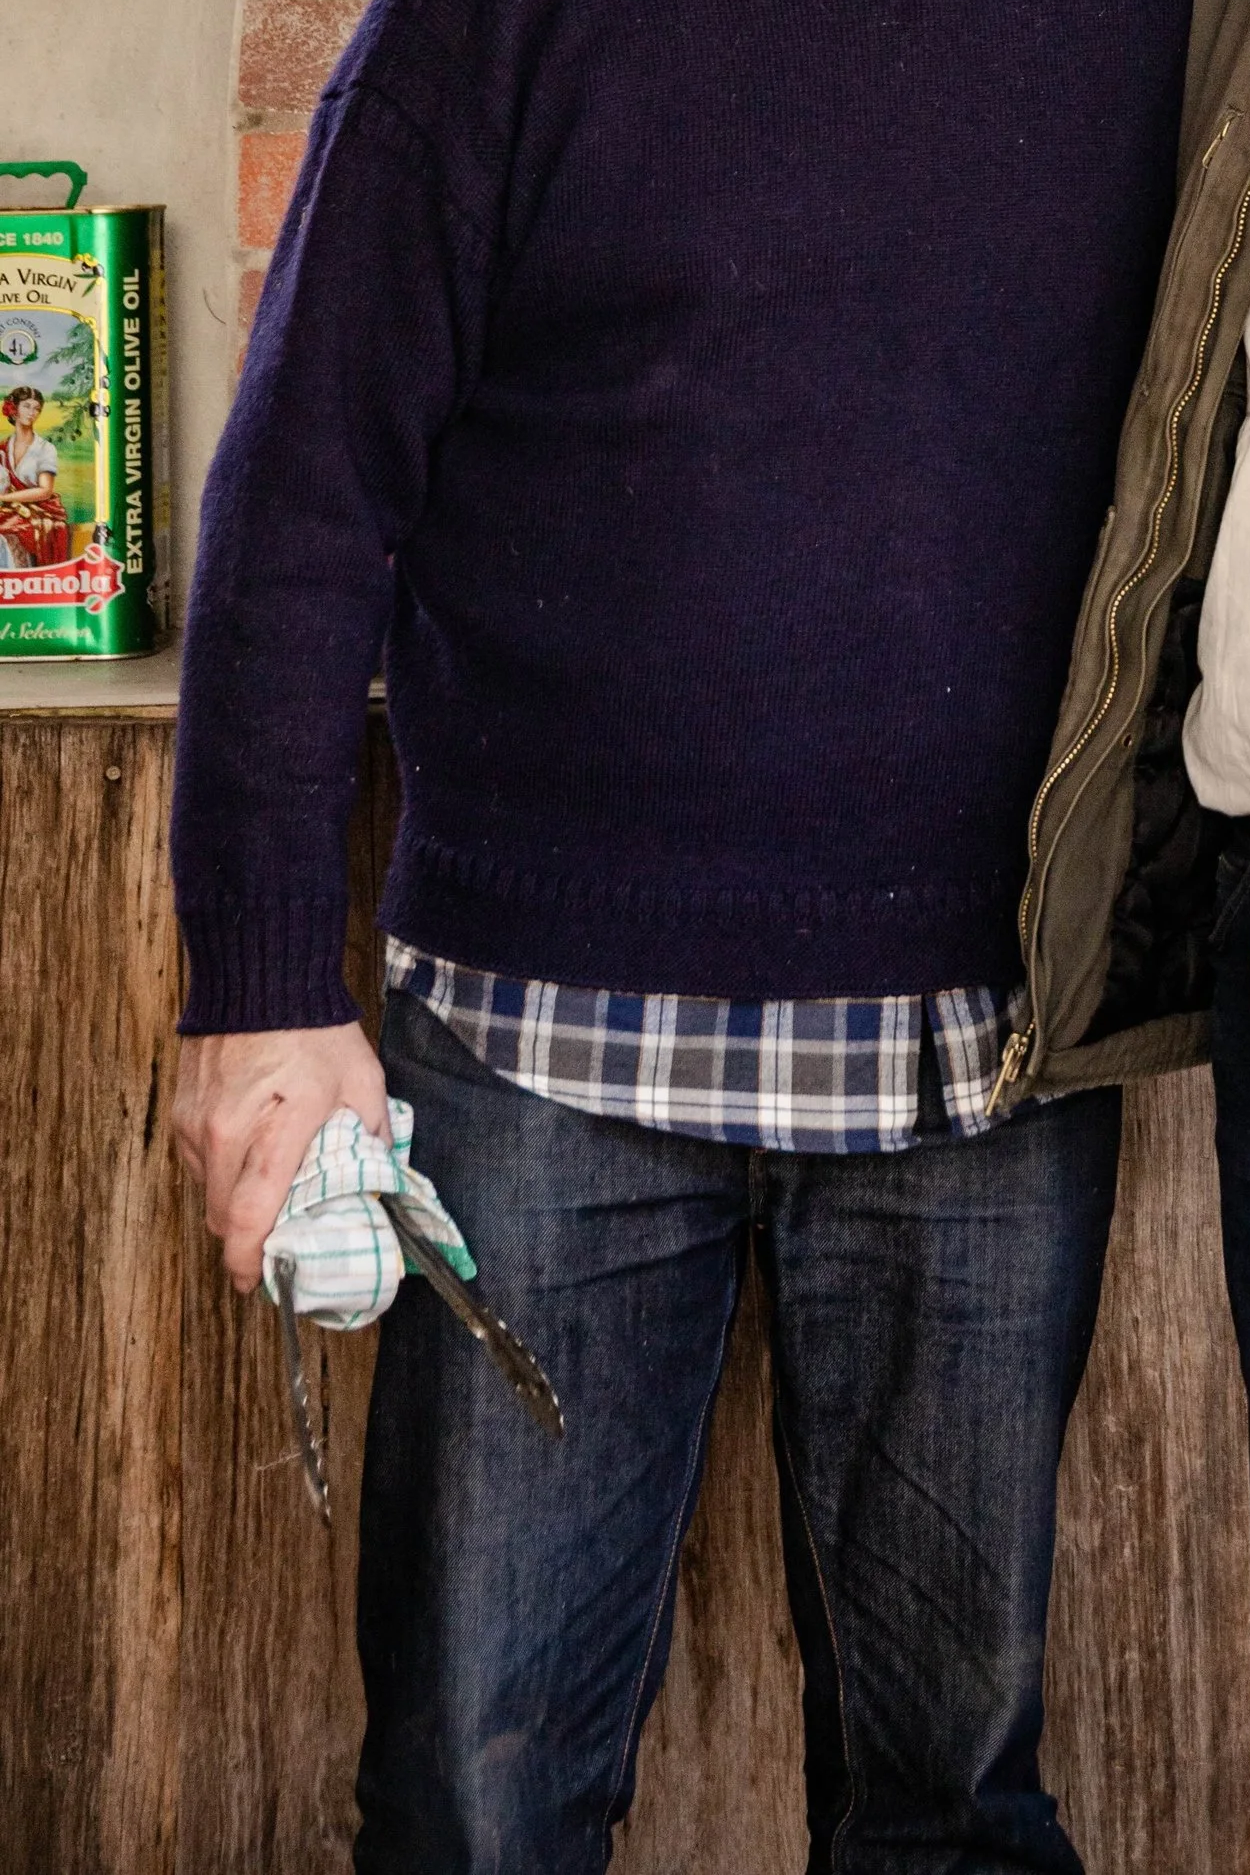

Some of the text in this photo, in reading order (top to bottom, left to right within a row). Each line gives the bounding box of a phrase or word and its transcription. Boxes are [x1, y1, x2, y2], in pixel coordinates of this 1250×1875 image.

[23, 232, 64, 246] 1840
[17, 268, 78, 293] VIRGIN
[26, 289, 52, 305] OIL
[122, 268, 143, 575] EXTRA VIRGIN OLIVE OIL
